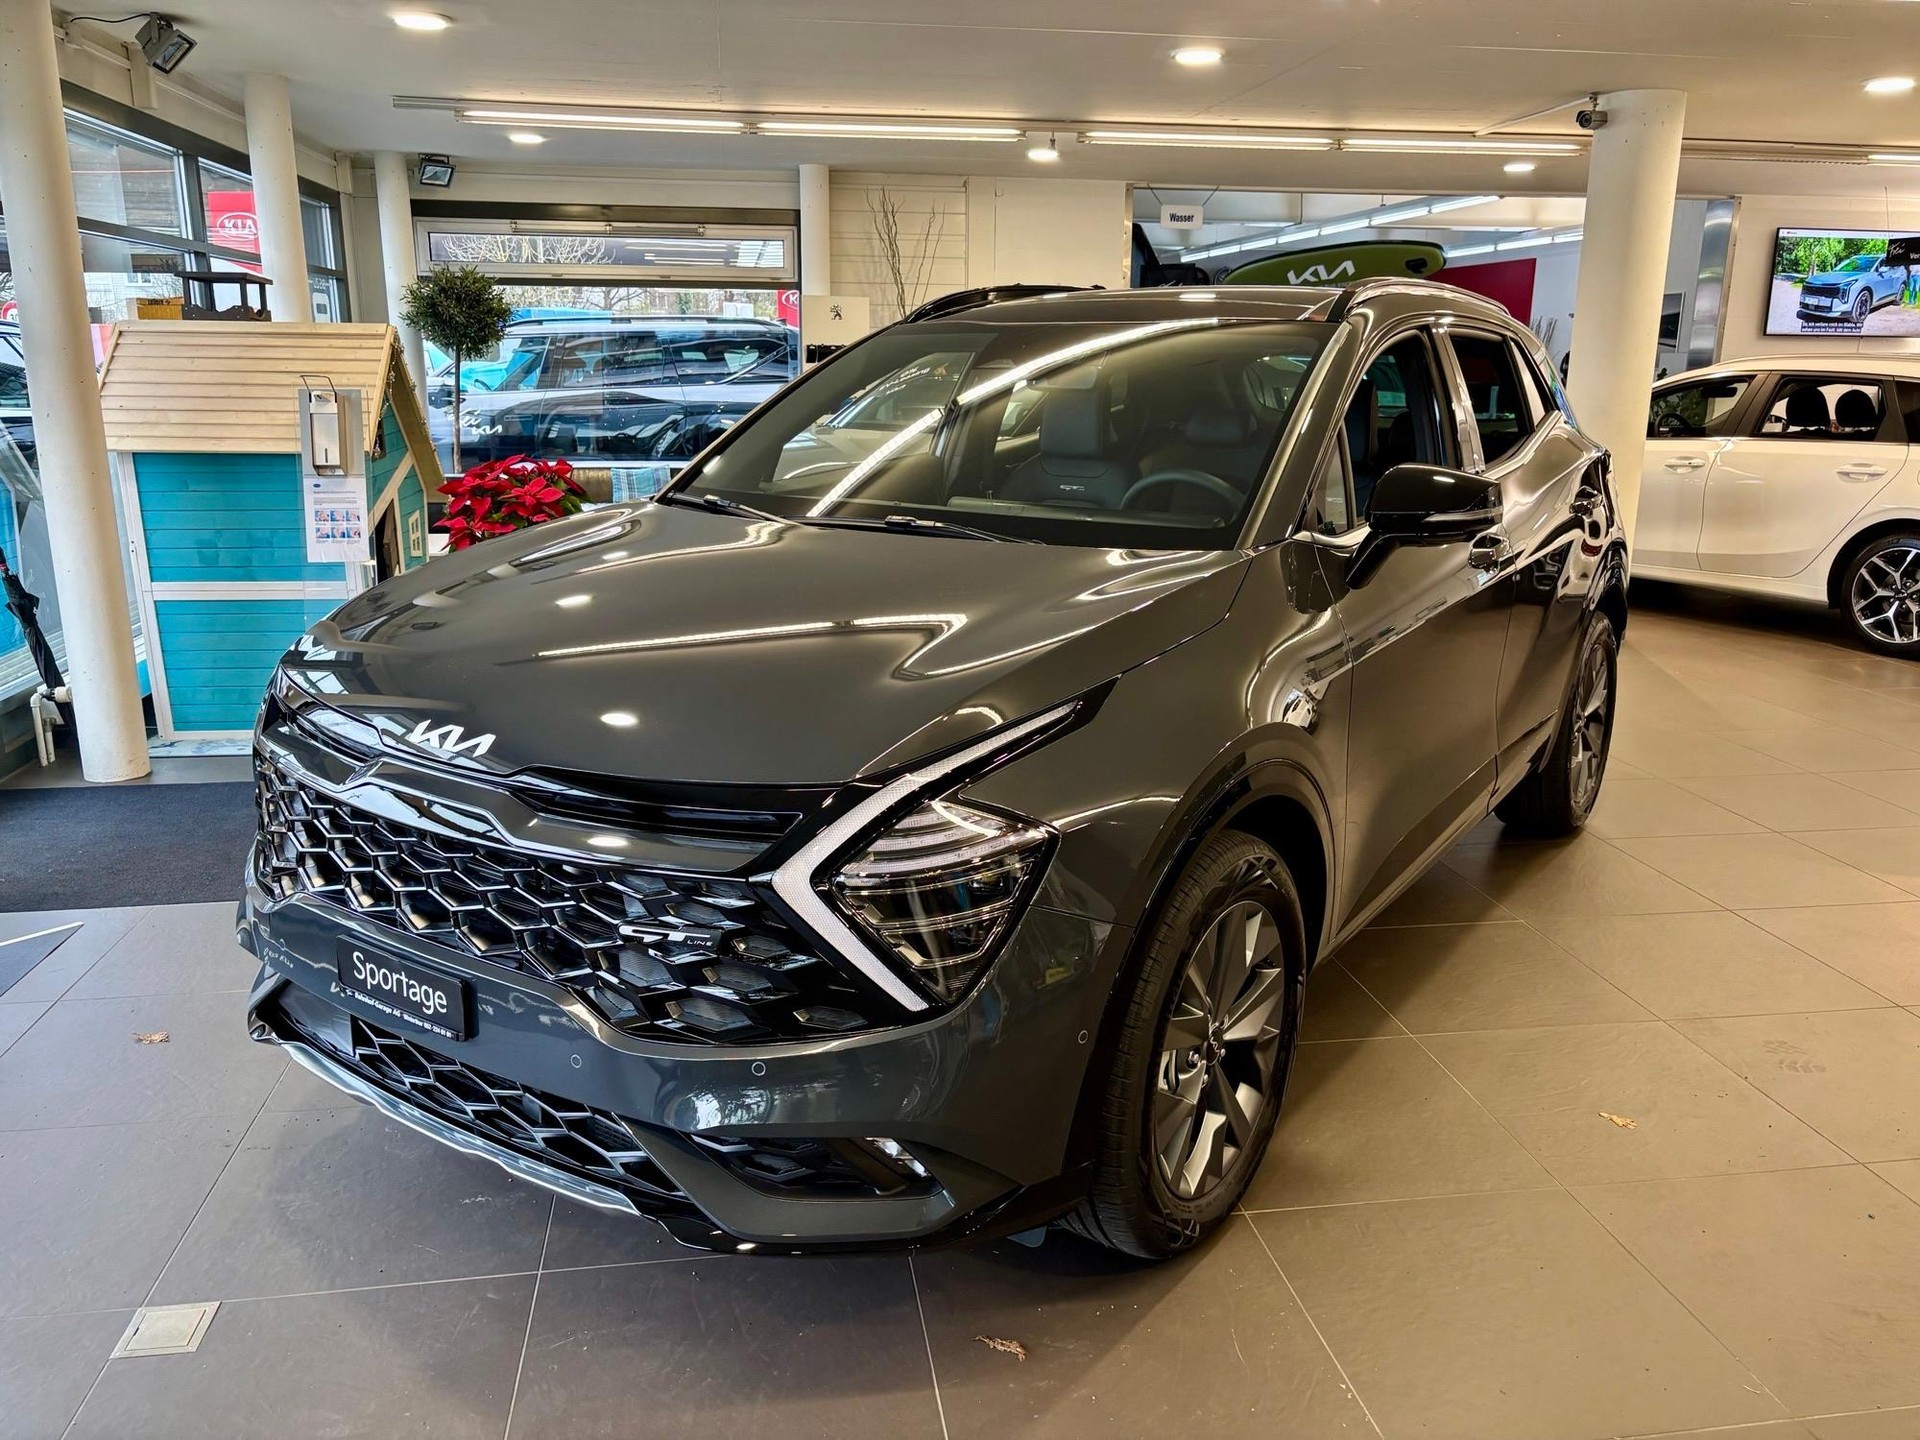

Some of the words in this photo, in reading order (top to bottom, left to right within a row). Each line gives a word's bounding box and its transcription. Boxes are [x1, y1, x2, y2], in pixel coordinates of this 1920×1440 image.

[223, 219, 257, 234] KIA
[1168, 212, 1195, 223] Wasser
[1287, 260, 1356, 285] KIA
[405, 719, 496, 758] KIA
[619, 925, 711, 943] GT
[686, 939, 714, 947] LINE
[352, 951, 448, 1015] Sportage
